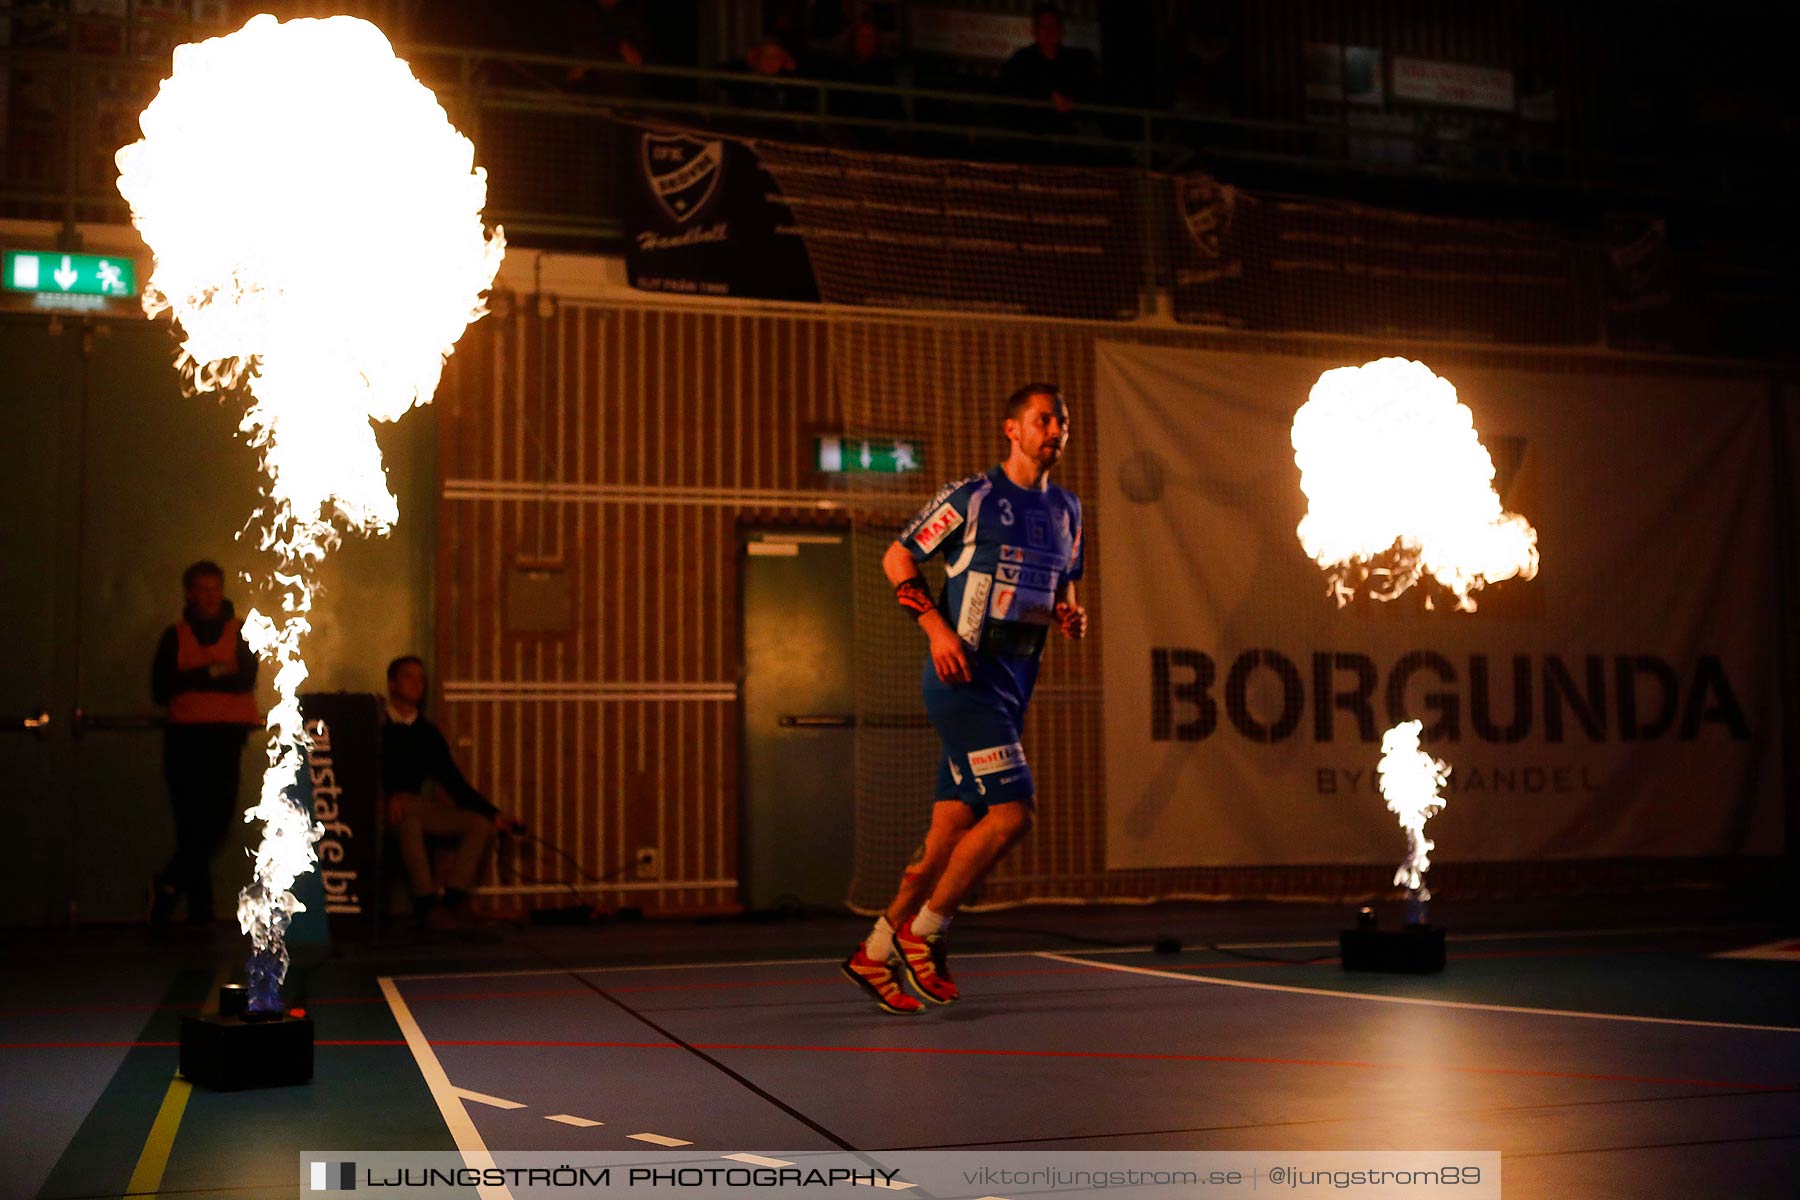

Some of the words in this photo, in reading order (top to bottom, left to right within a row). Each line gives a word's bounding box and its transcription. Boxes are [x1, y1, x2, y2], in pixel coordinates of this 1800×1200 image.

[913, 508, 957, 549] MAXI
[998, 498, 1016, 526] 3
[1151, 647, 1751, 744] BORGUNDA
[1316, 767, 1600, 794] BYANDEL
